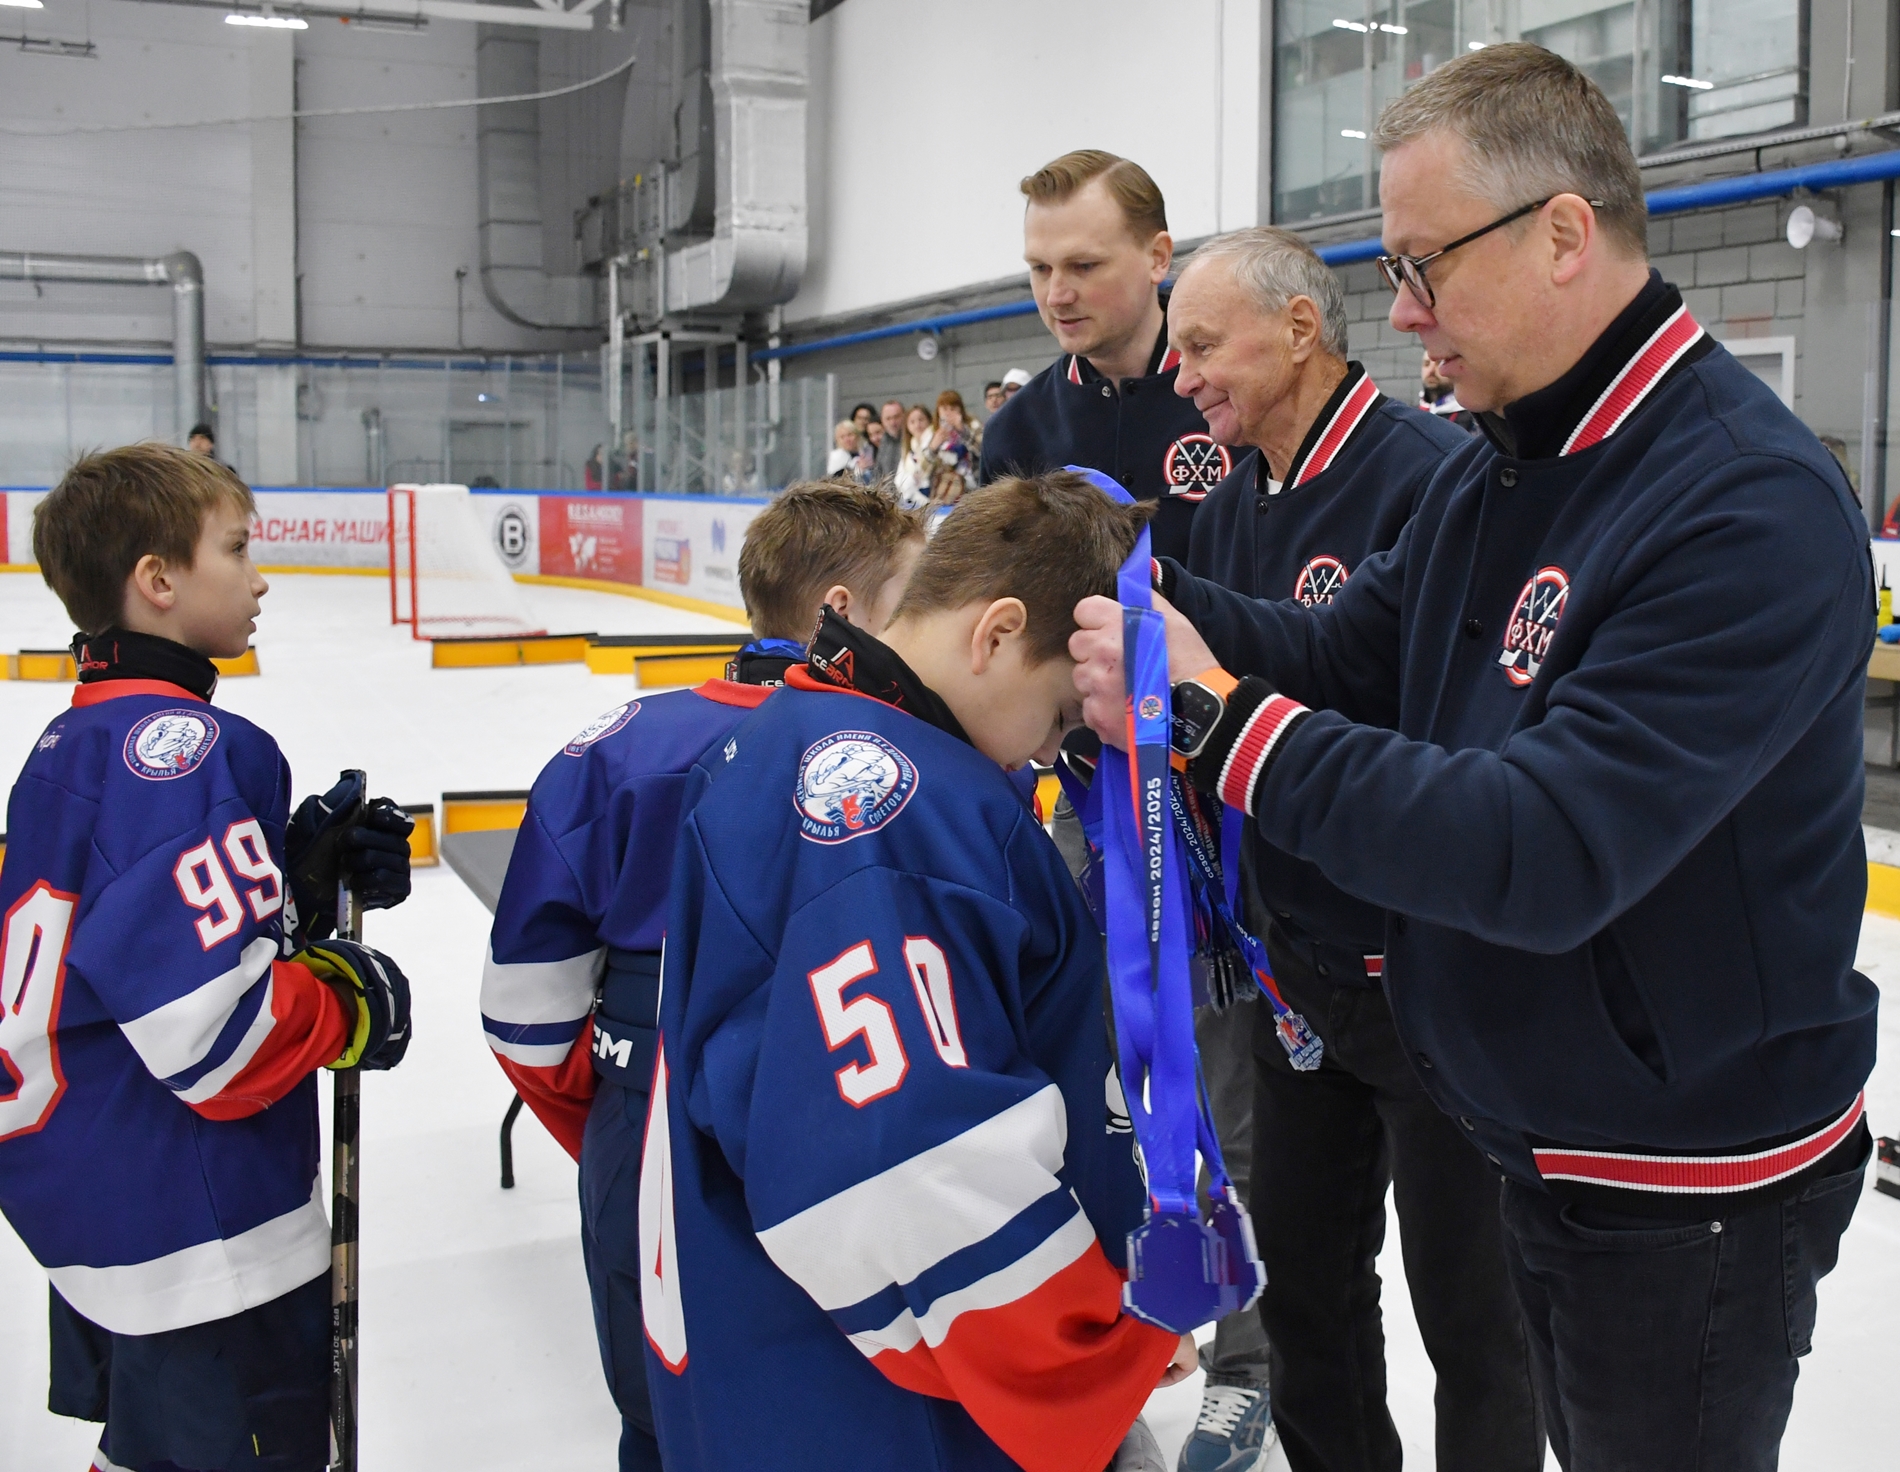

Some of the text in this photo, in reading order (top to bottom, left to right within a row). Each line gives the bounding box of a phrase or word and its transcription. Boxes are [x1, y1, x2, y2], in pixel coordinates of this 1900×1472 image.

[1172, 465, 1222, 482] ФХМ
[249, 518, 327, 544] АСНАЯ
[1511, 618, 1554, 657] ФХМ
[804, 738, 835, 763] ШКОЛА
[141, 766, 177, 777] КРЫЛЬЯ
[802, 817, 840, 837] КРЫЛЬЯ
[1146, 777, 1163, 881] 2024/2025
[1195, 848, 1214, 879] сезон
[174, 818, 283, 951] 99
[807, 936, 969, 1109] 50
